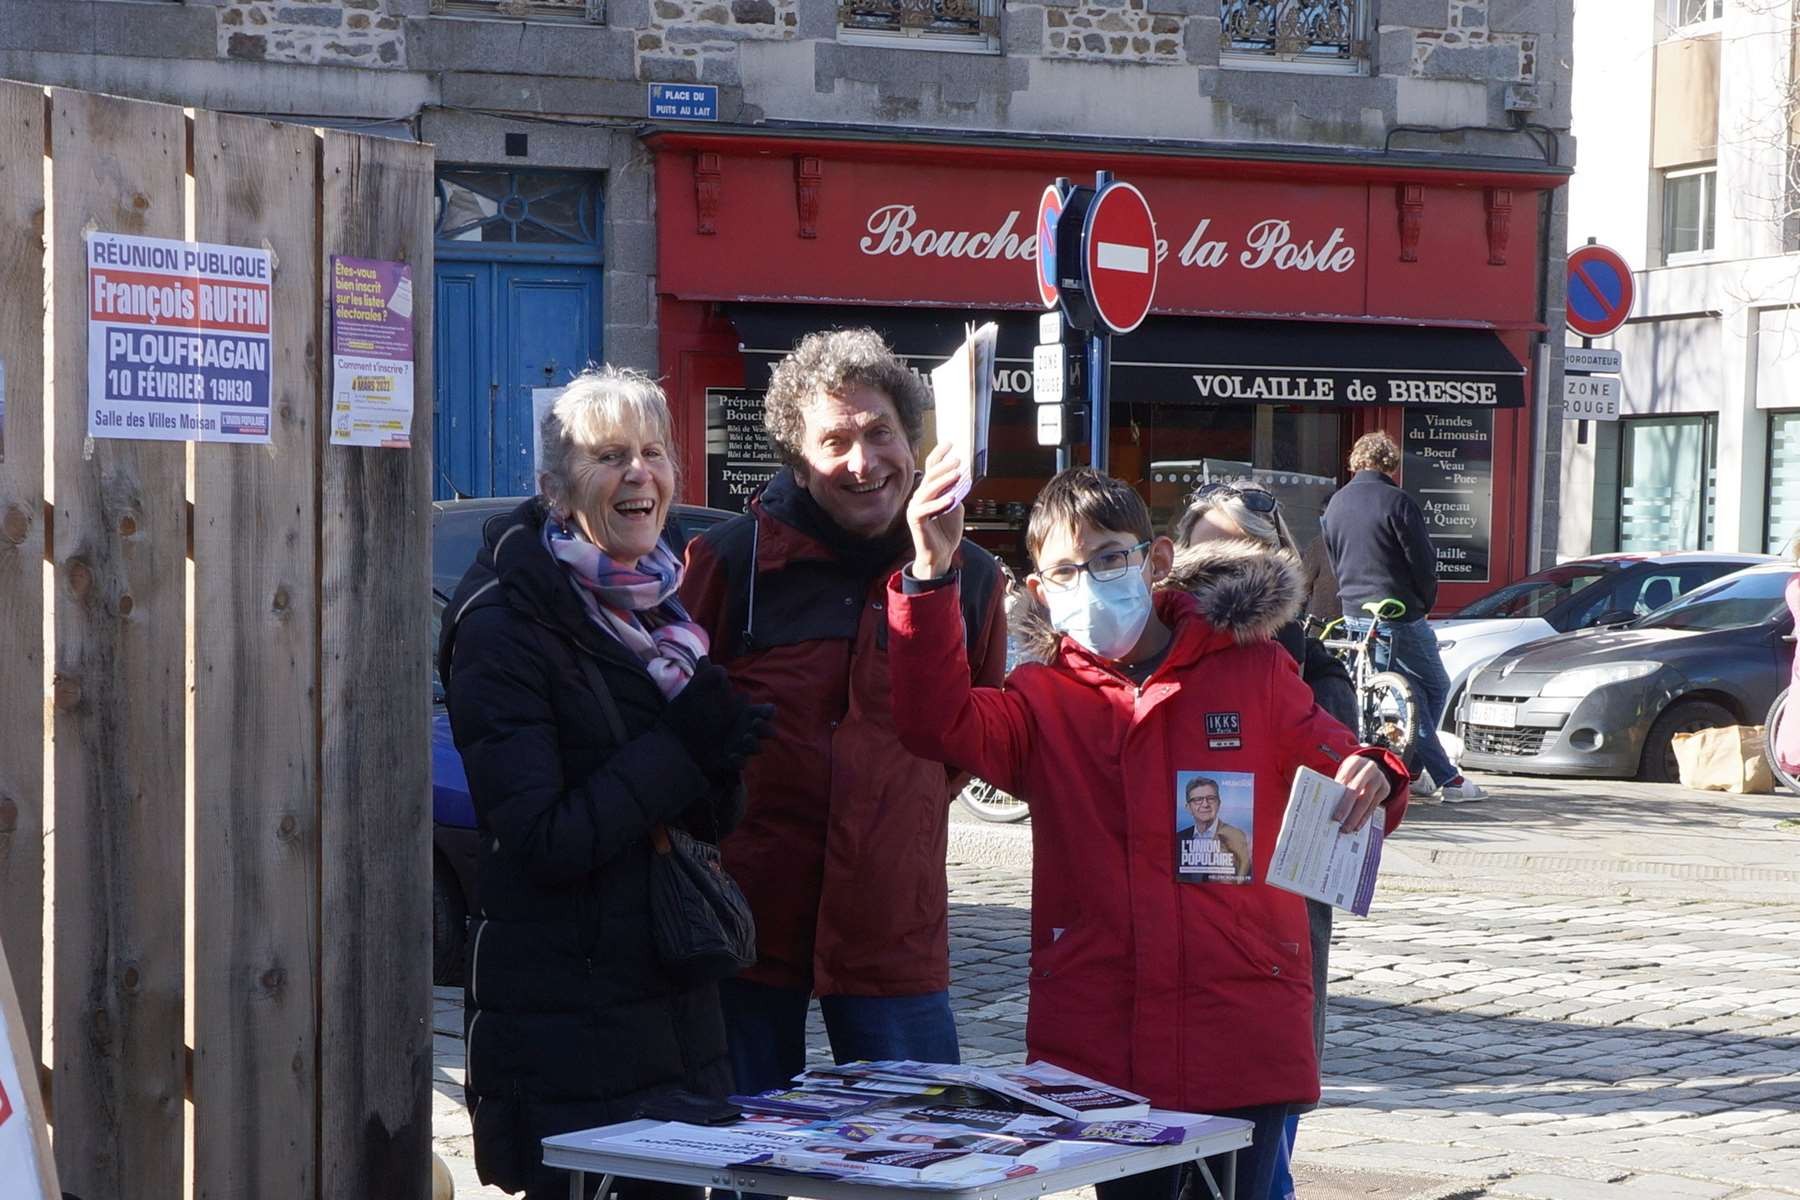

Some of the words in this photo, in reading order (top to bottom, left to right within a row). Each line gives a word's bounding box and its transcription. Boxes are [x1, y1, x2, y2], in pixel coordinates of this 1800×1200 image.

[665, 91, 690, 101] PLACE
[694, 92, 705, 101] DU
[656, 105, 676, 114] PUITS
[680, 106, 691, 115] AU
[694, 107, 711, 116] LAIT
[860, 204, 1038, 260] Bouche
[1178, 219, 1229, 268] la
[1240, 219, 1355, 272] Poste
[94, 237, 178, 270] RÉUNION
[185, 250, 266, 279] PUBLIQUE
[336, 276, 354, 290] bien
[355, 278, 382, 293] inscrit
[94, 275, 195, 325] François
[200, 284, 267, 326] RUFFIN
[336, 294, 350, 303] sur
[351, 292, 362, 305] les
[364, 293, 385, 308] listes
[109, 332, 265, 371] PLOUFRAGAN
[1567, 355, 1618, 366] ORODATEUR
[108, 369, 132, 396] 10
[138, 366, 205, 399] FÉVRIER
[210, 379, 252, 402] 19H30
[1193, 375, 1334, 400] VOLAILLE
[1347, 380, 1376, 401] de
[1388, 380, 1498, 404] BRESSE
[1568, 382, 1610, 396] ZONE
[1563, 400, 1615, 414] ROUGE
[95, 410, 122, 427] Salle
[127, 412, 144, 428] des
[148, 413, 176, 429] Villes
[180, 414, 216, 430] Moisan
[1425, 415, 1472, 427] Viandes
[1409, 429, 1424, 440] du
[1429, 429, 1488, 440] Limousin
[1424, 500, 1470, 514] Agneau
[1434, 514, 1478, 528] Quercy
[1436, 548, 1467, 559] laille
[1435, 562, 1472, 572] Bresse
[1210, 716, 1237, 728] IKKS
[1181, 853, 1234, 866] POPULAIRE
